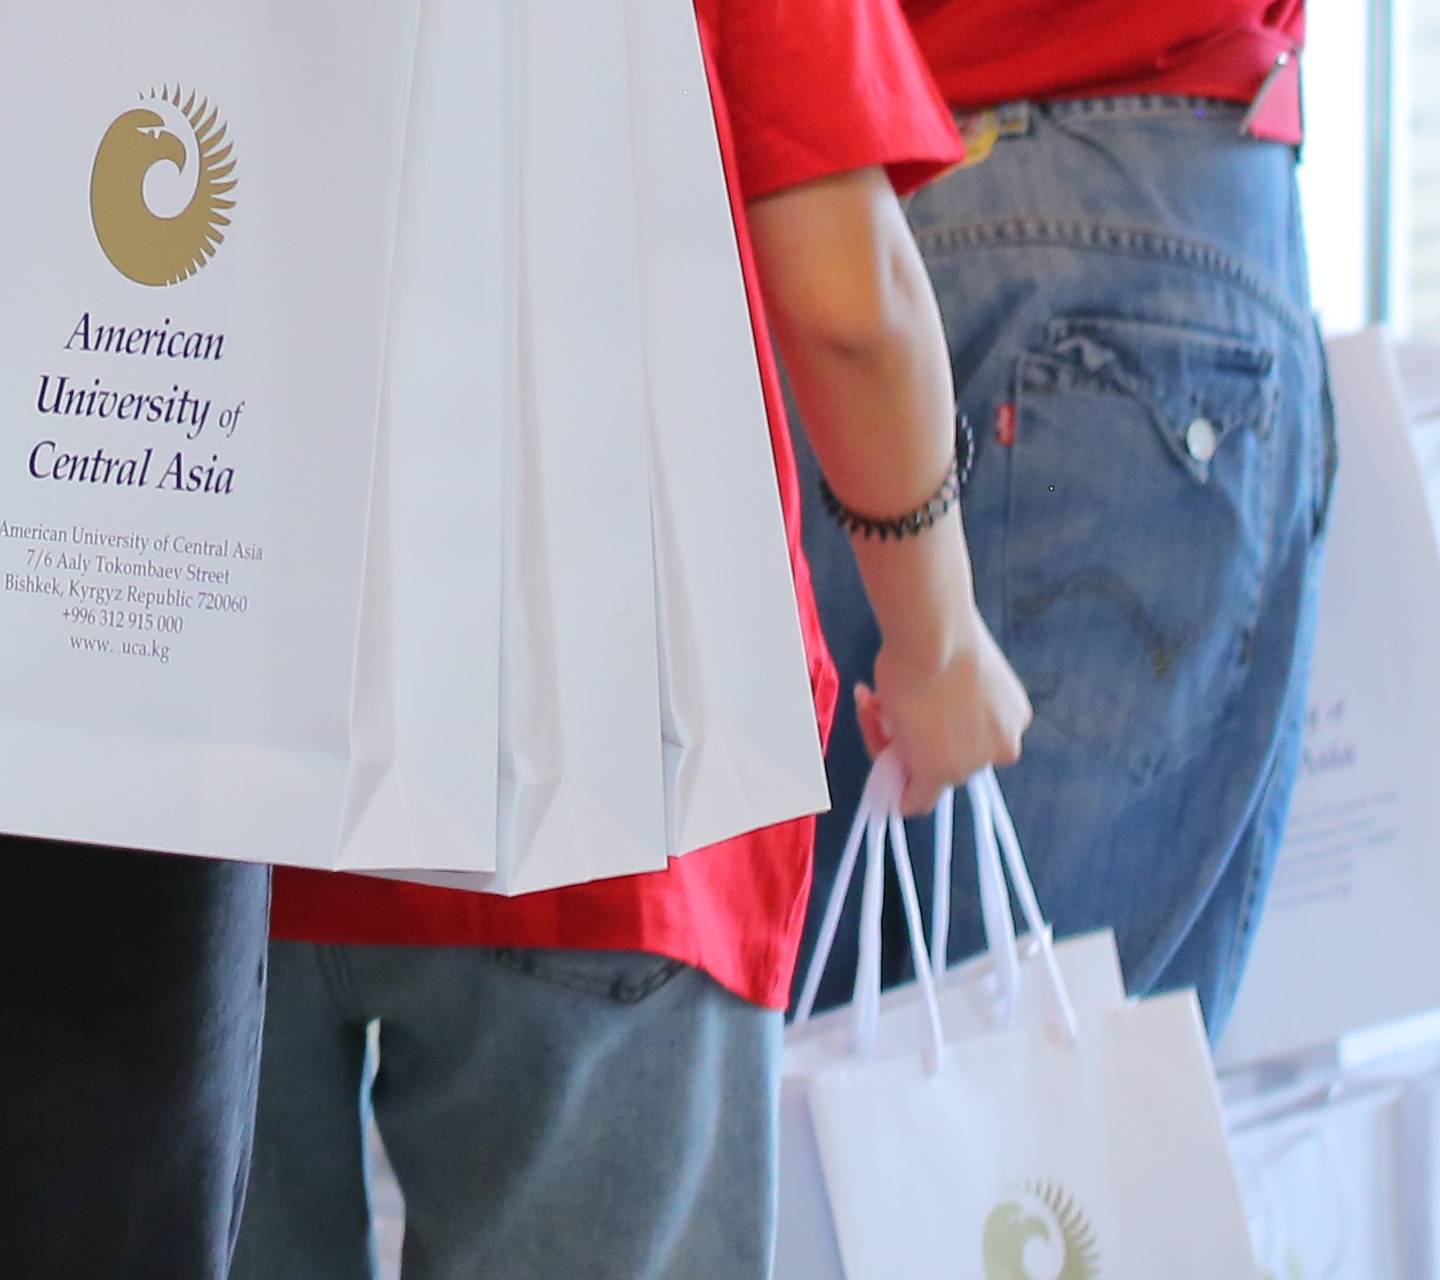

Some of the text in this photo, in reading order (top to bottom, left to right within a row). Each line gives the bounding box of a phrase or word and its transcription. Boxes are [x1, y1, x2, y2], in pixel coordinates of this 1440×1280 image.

[63, 311, 225, 361] American
[36, 374, 245, 440] University of
[28, 440, 236, 496] Central Asia
[71, 525, 150, 556] University
[152, 534, 171, 553] of
[172, 536, 229, 558] Central
[232, 542, 264, 561] Asia
[25, 548, 231, 585] 7/6 Aaly Tokombaev Street
[4, 573, 249, 614] Bishkek, Kyrgyz Republic 720060
[62, 606, 184, 635] +996 312 915 000
